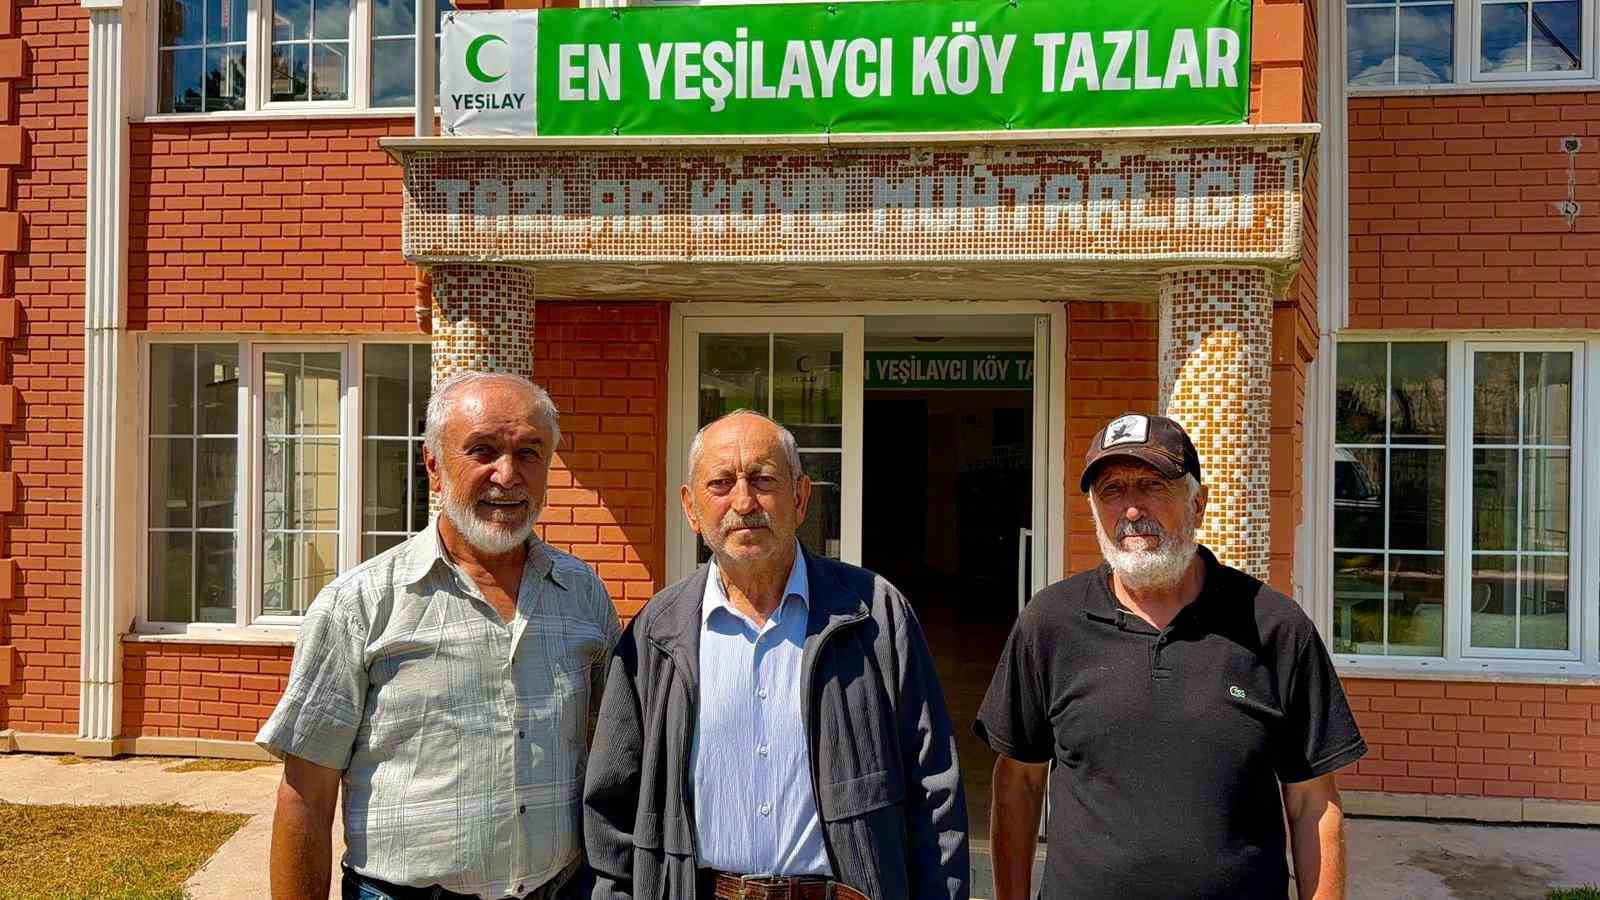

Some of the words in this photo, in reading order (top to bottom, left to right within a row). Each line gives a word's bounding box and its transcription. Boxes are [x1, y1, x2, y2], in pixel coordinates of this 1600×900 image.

[558, 43, 621, 102] EN
[638, 27, 893, 113] YEŞİLAYCI
[911, 21, 1017, 96] KÖY
[1034, 27, 1240, 93] TAZLAR
[451, 93, 526, 113] YEŞİLAY
[435, 179, 666, 232] TAZLAR
[876, 355, 967, 385] YEŞİLAYCI
[973, 355, 1010, 381] KÖY
